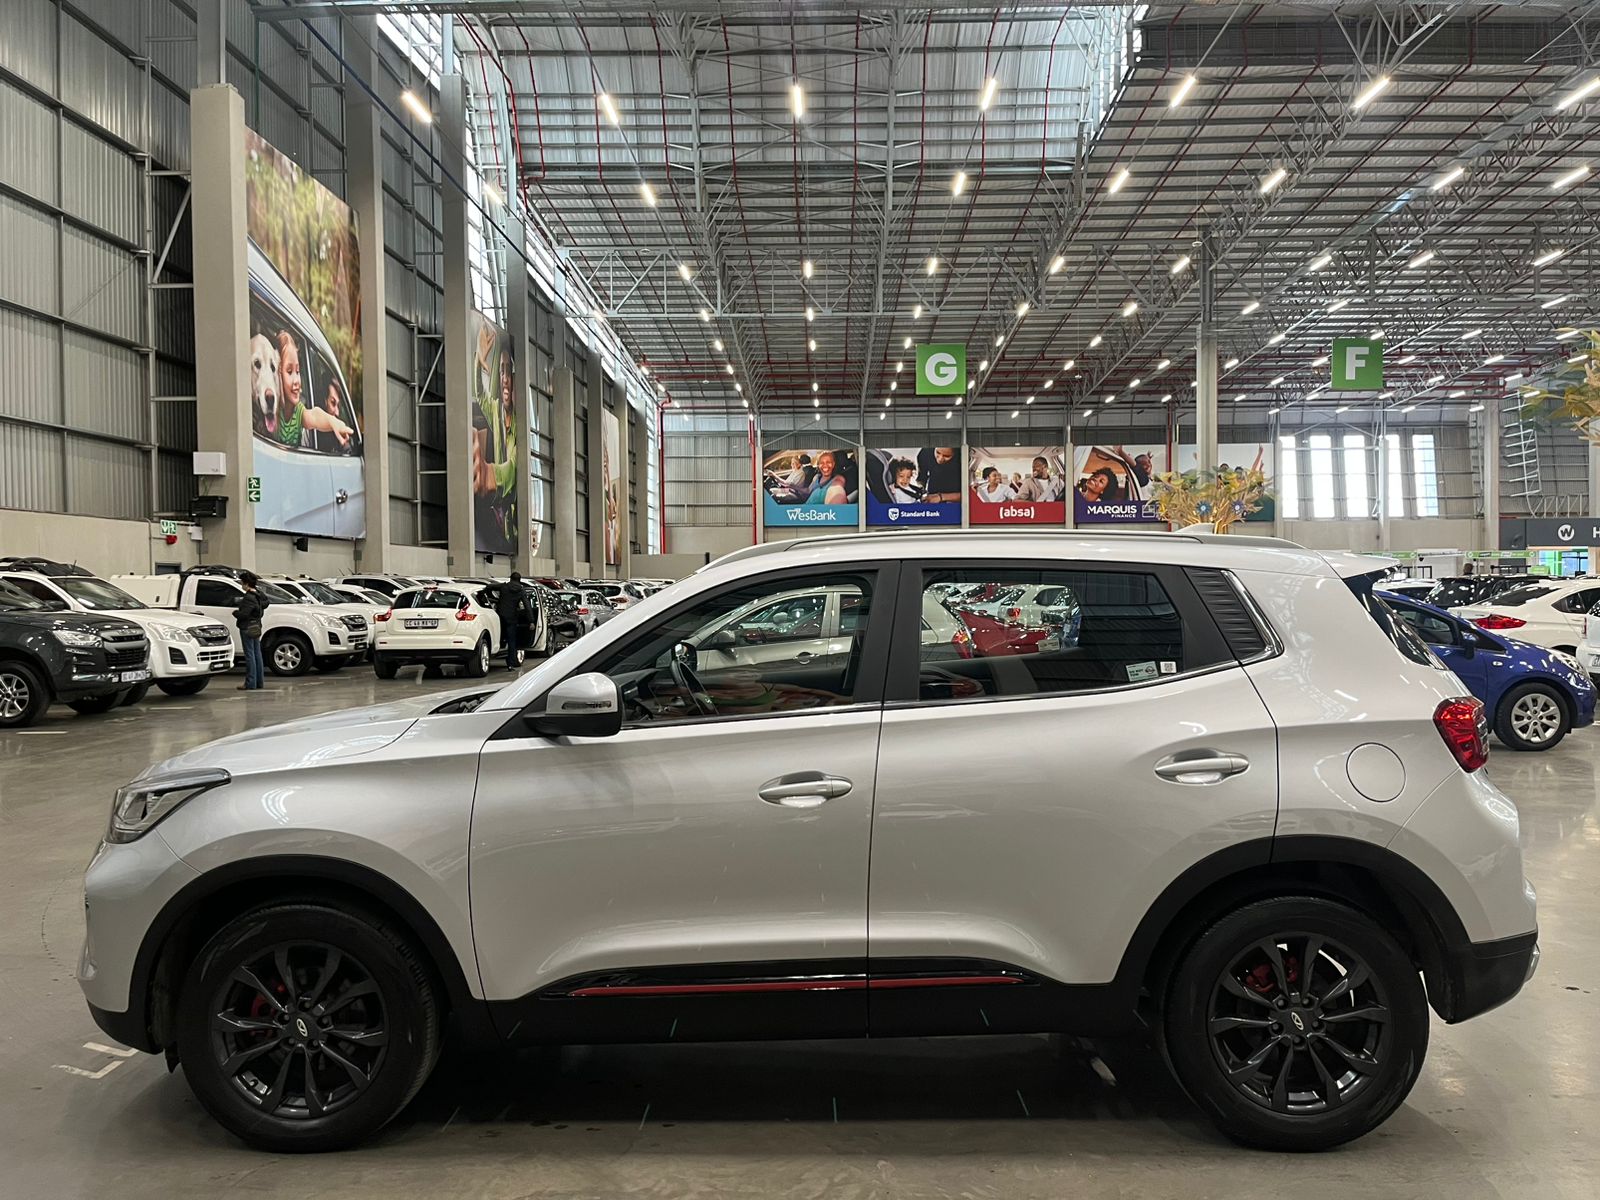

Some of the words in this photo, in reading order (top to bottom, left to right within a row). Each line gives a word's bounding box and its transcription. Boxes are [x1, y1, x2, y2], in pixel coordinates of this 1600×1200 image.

[925, 352, 958, 387] G
[1345, 346, 1370, 381] F
[786, 508, 837, 521] WesBank
[900, 510, 926, 518] Standard
[1087, 505, 1138, 515] MARQUIS
